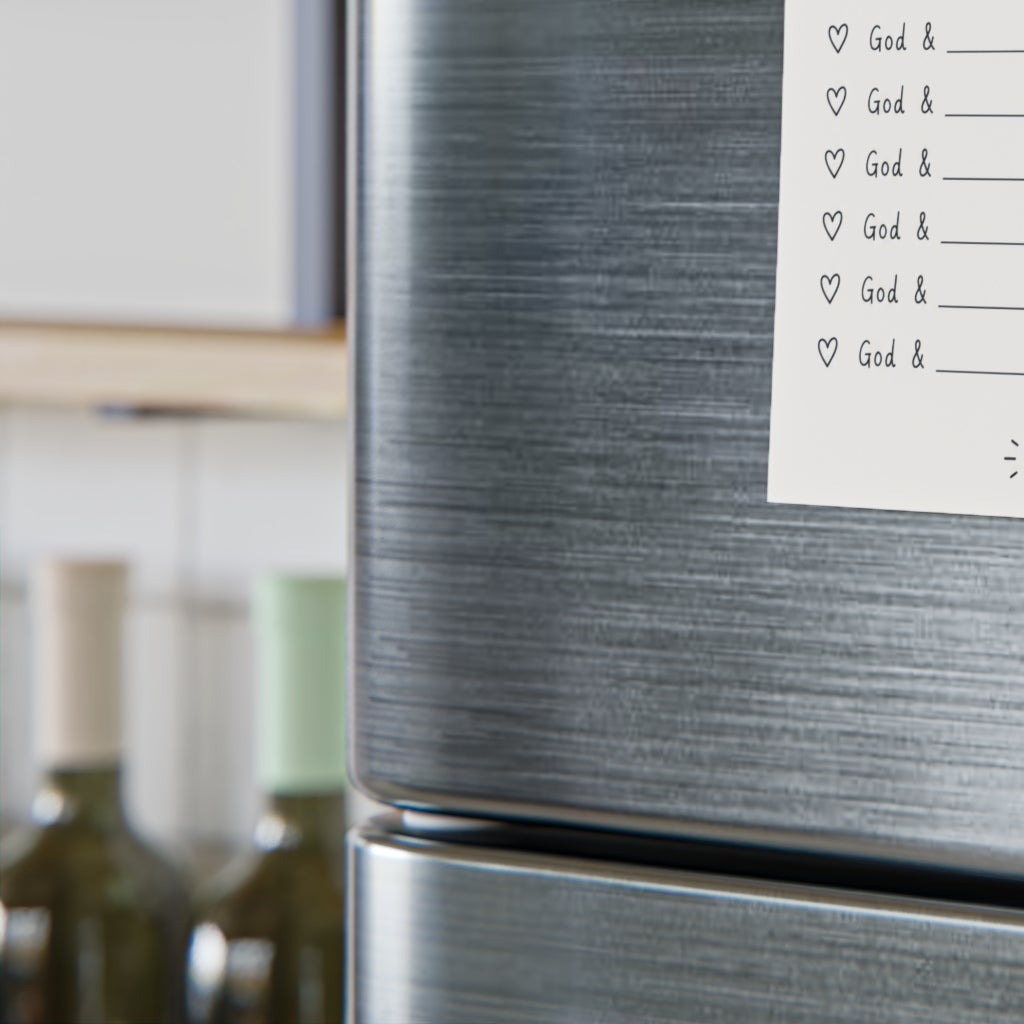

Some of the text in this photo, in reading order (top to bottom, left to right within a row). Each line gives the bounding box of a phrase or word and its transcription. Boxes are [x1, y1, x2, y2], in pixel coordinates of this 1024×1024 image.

[870, 22, 935, 52] God &
[868, 85, 933, 115] God &
[866, 148, 931, 178] God &
[864, 211, 929, 240] God &
[862, 274, 927, 304] God &
[859, 338, 924, 368] God &
